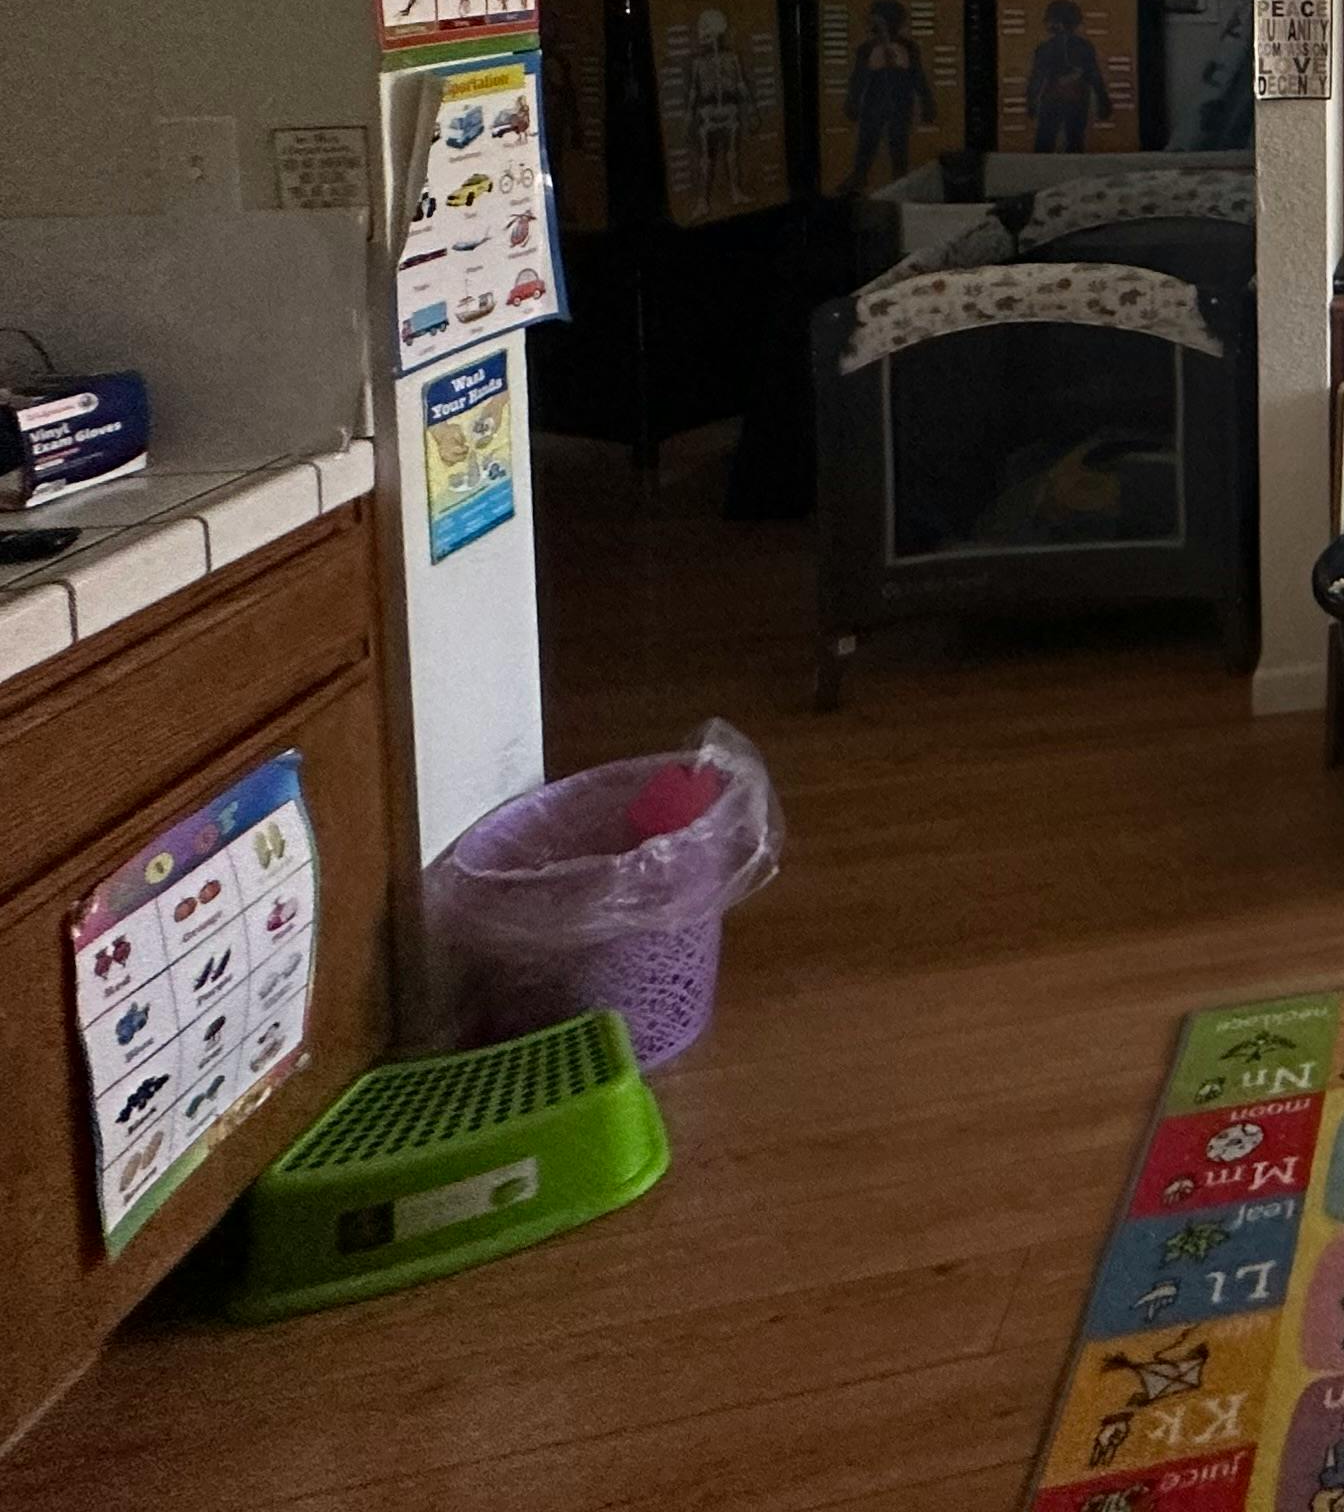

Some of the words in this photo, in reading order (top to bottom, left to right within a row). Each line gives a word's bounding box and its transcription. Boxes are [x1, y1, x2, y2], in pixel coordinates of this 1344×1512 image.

[1257, 0, 1328, 18] PEACE
[1257, 18, 1328, 41] HUMANITY
[1258, 57, 1327, 75] LOVE
[1258, 75, 1328, 96] DECENCY
[432, 397, 466, 418] Your
[29, 422, 71, 442] Vinyl
[33, 434, 73, 455] Exam
[75, 421, 122, 442] Gloves
[1228, 1099, 1311, 1121] moon
[1228, 1203, 1295, 1230] leaf
[1158, 1450, 1246, 1493] juice
